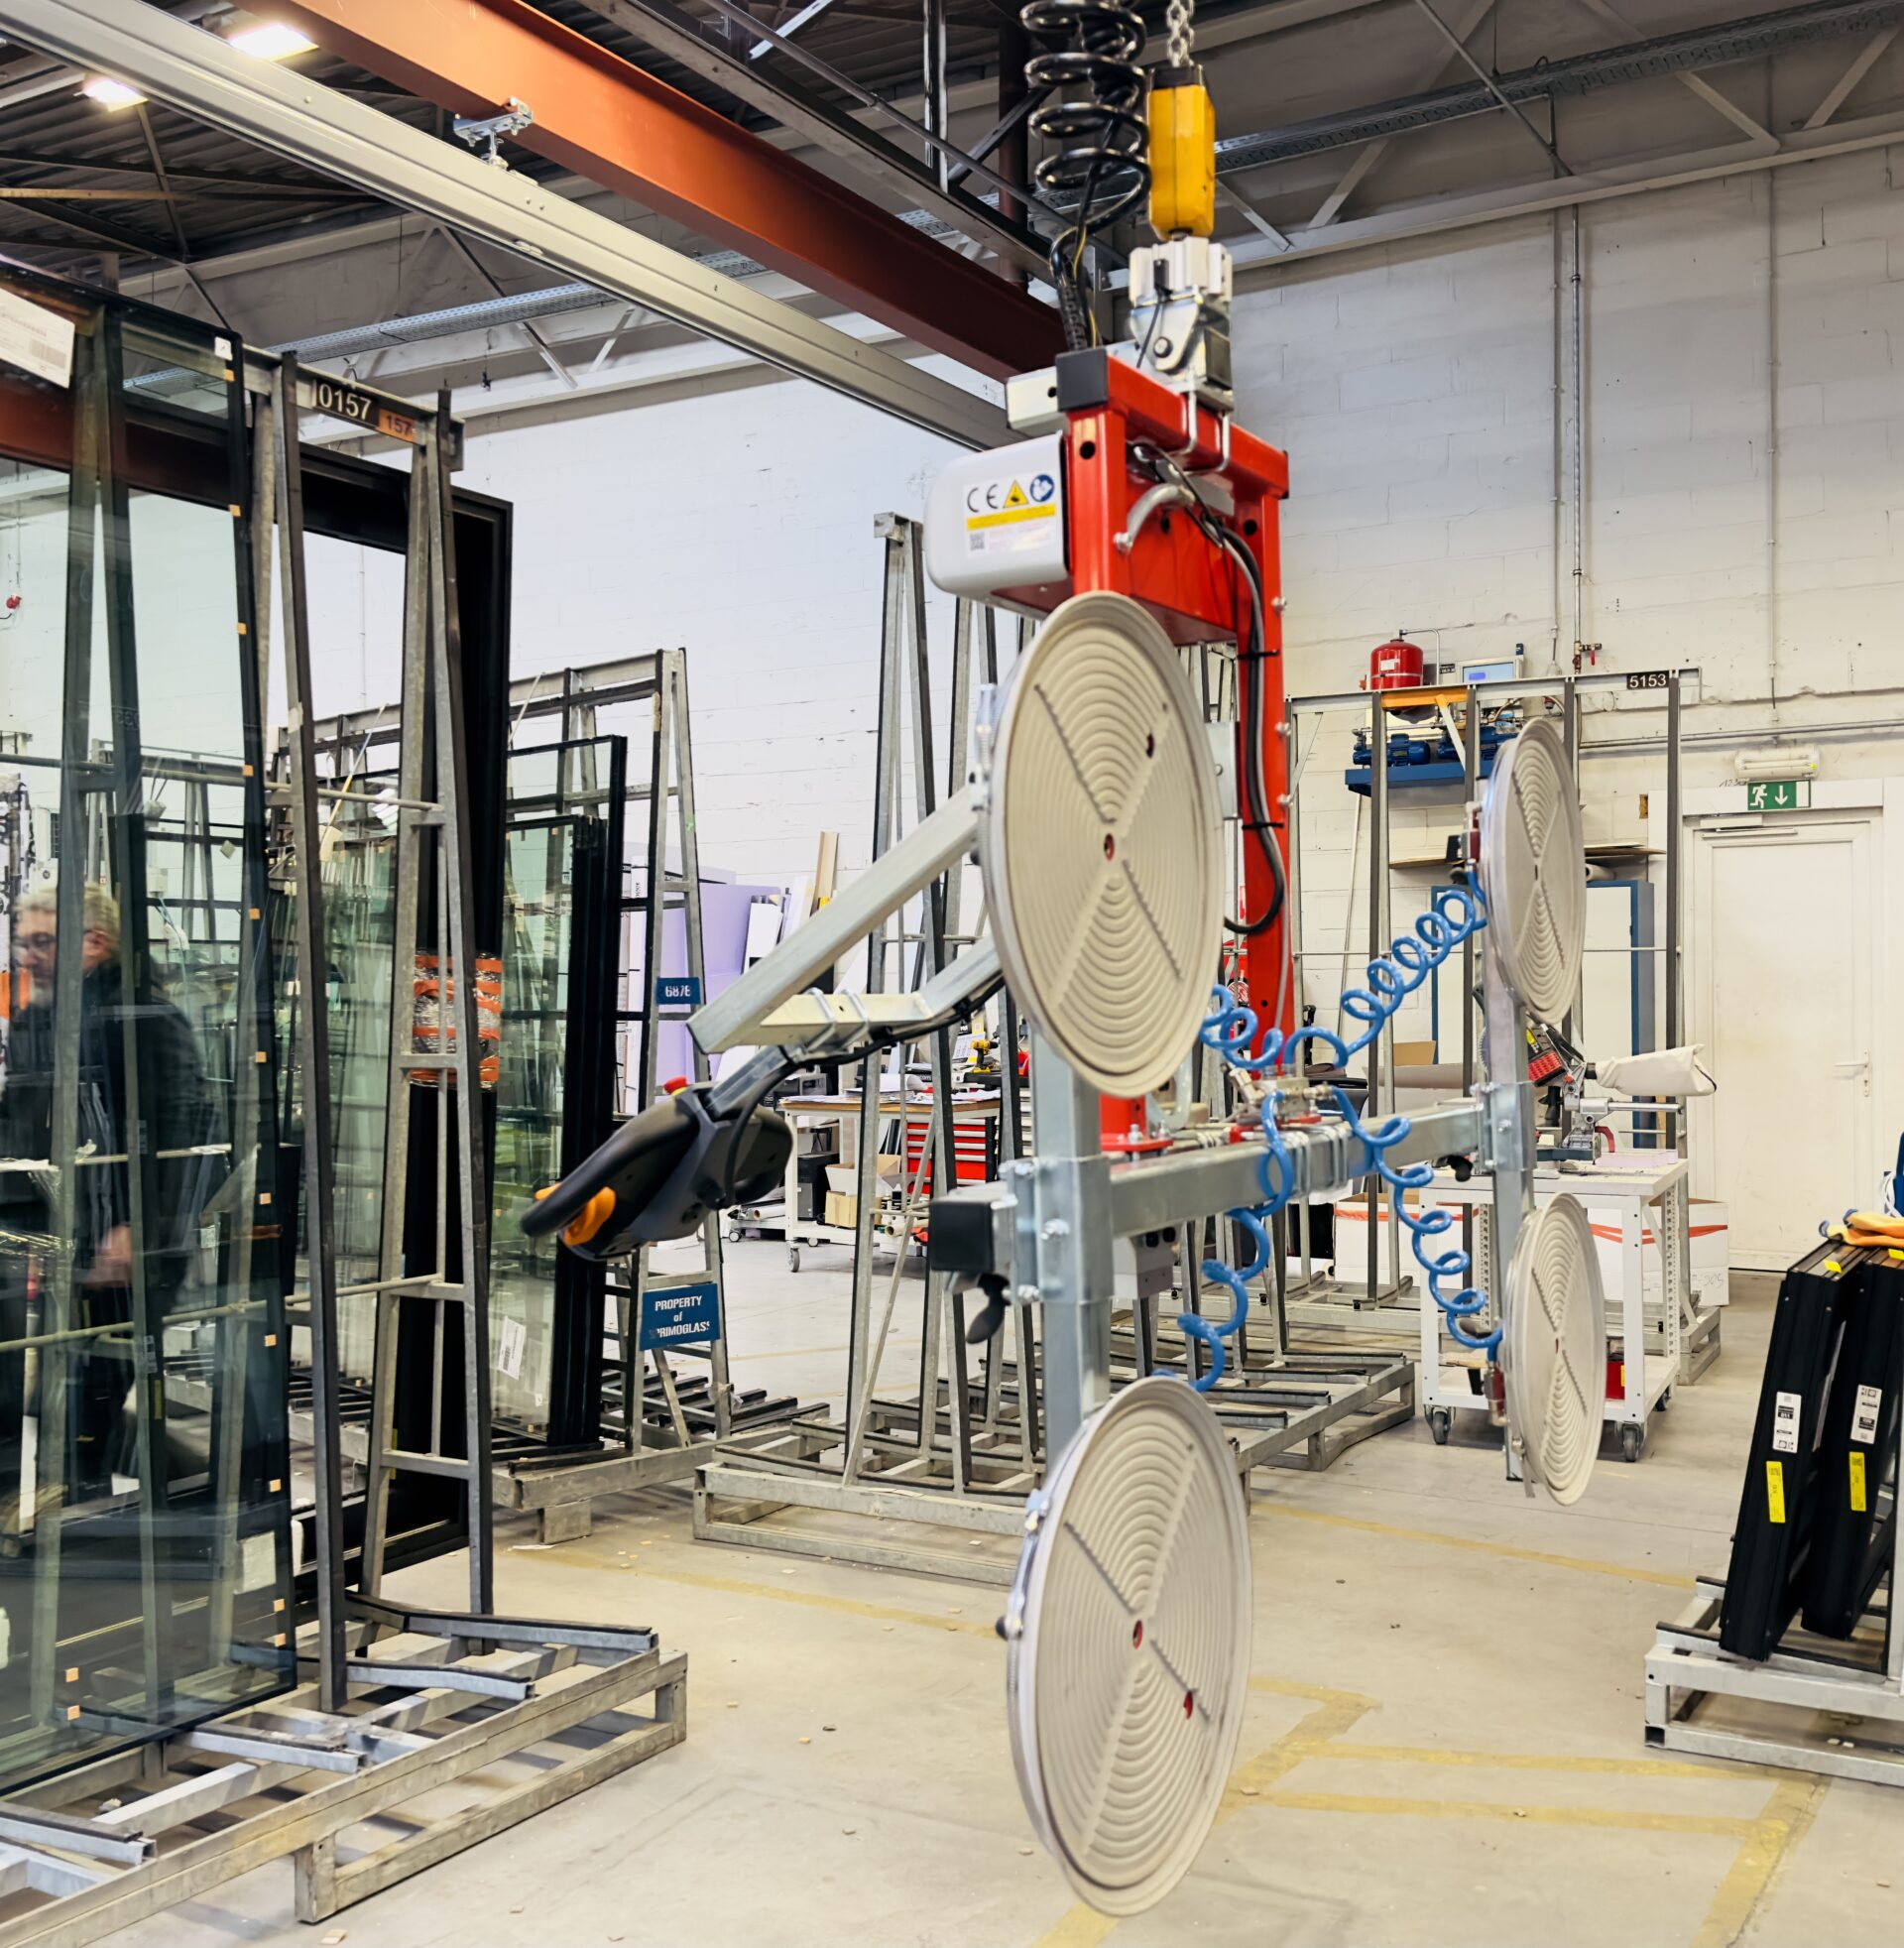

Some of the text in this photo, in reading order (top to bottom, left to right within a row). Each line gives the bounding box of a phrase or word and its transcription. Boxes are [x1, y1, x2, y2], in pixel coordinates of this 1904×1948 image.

[318, 383, 372, 421] 0157
[386, 414, 416, 435] 157
[967, 483, 999, 513] CE
[1629, 673, 1667, 688] 5153
[654, 1295, 702, 1311] PROPERTY
[673, 1311, 683, 1322] of
